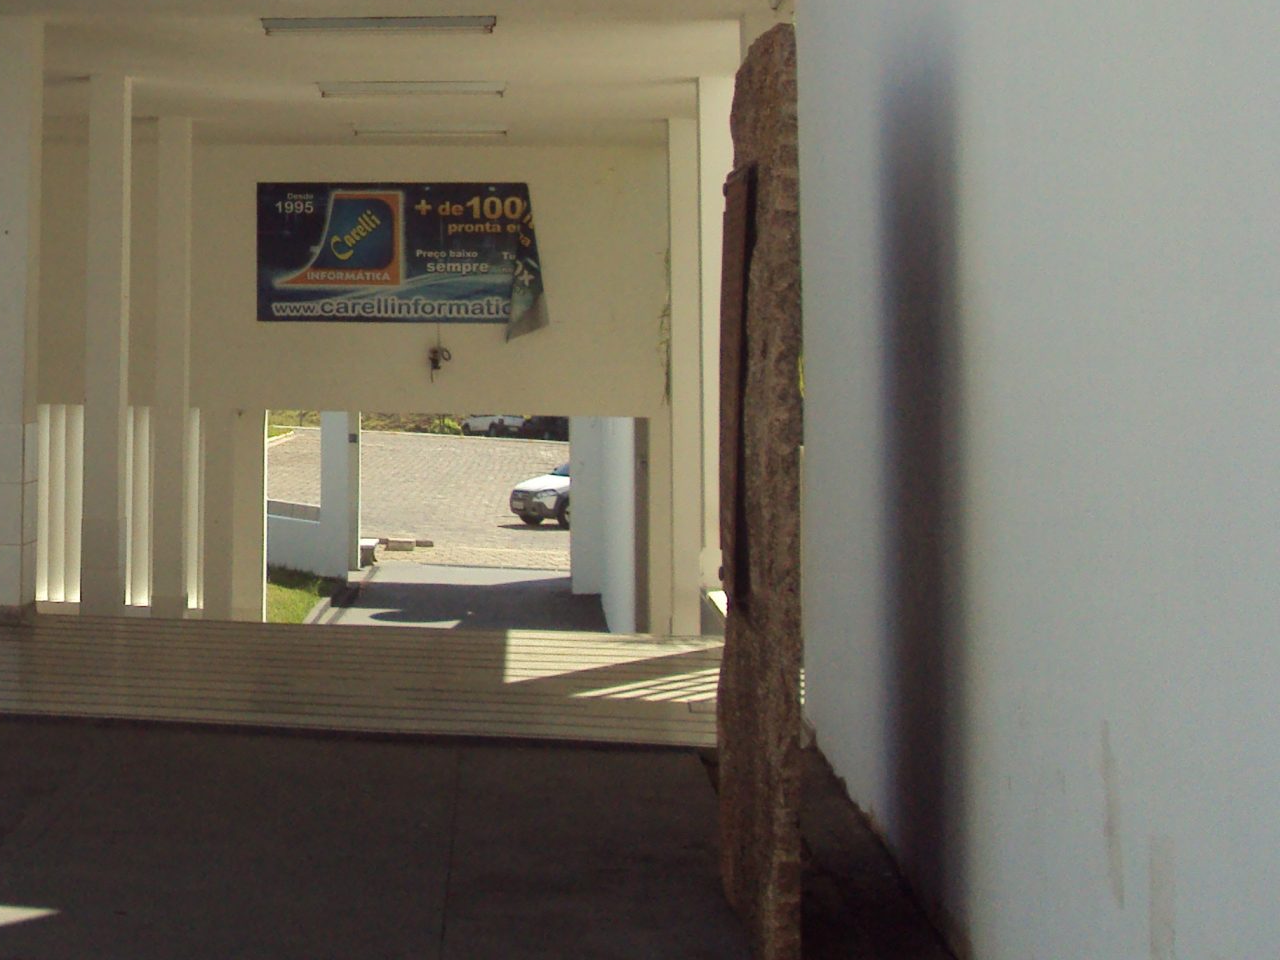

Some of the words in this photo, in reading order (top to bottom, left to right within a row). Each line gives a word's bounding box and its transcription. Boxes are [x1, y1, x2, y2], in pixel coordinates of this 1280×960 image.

[275, 200, 314, 214] 1995
[438, 201, 464, 216] de
[331, 208, 381, 260] Carelli
[447, 221, 502, 236] pronta
[416, 248, 447, 259] Preço
[426, 261, 489, 276] sempre
